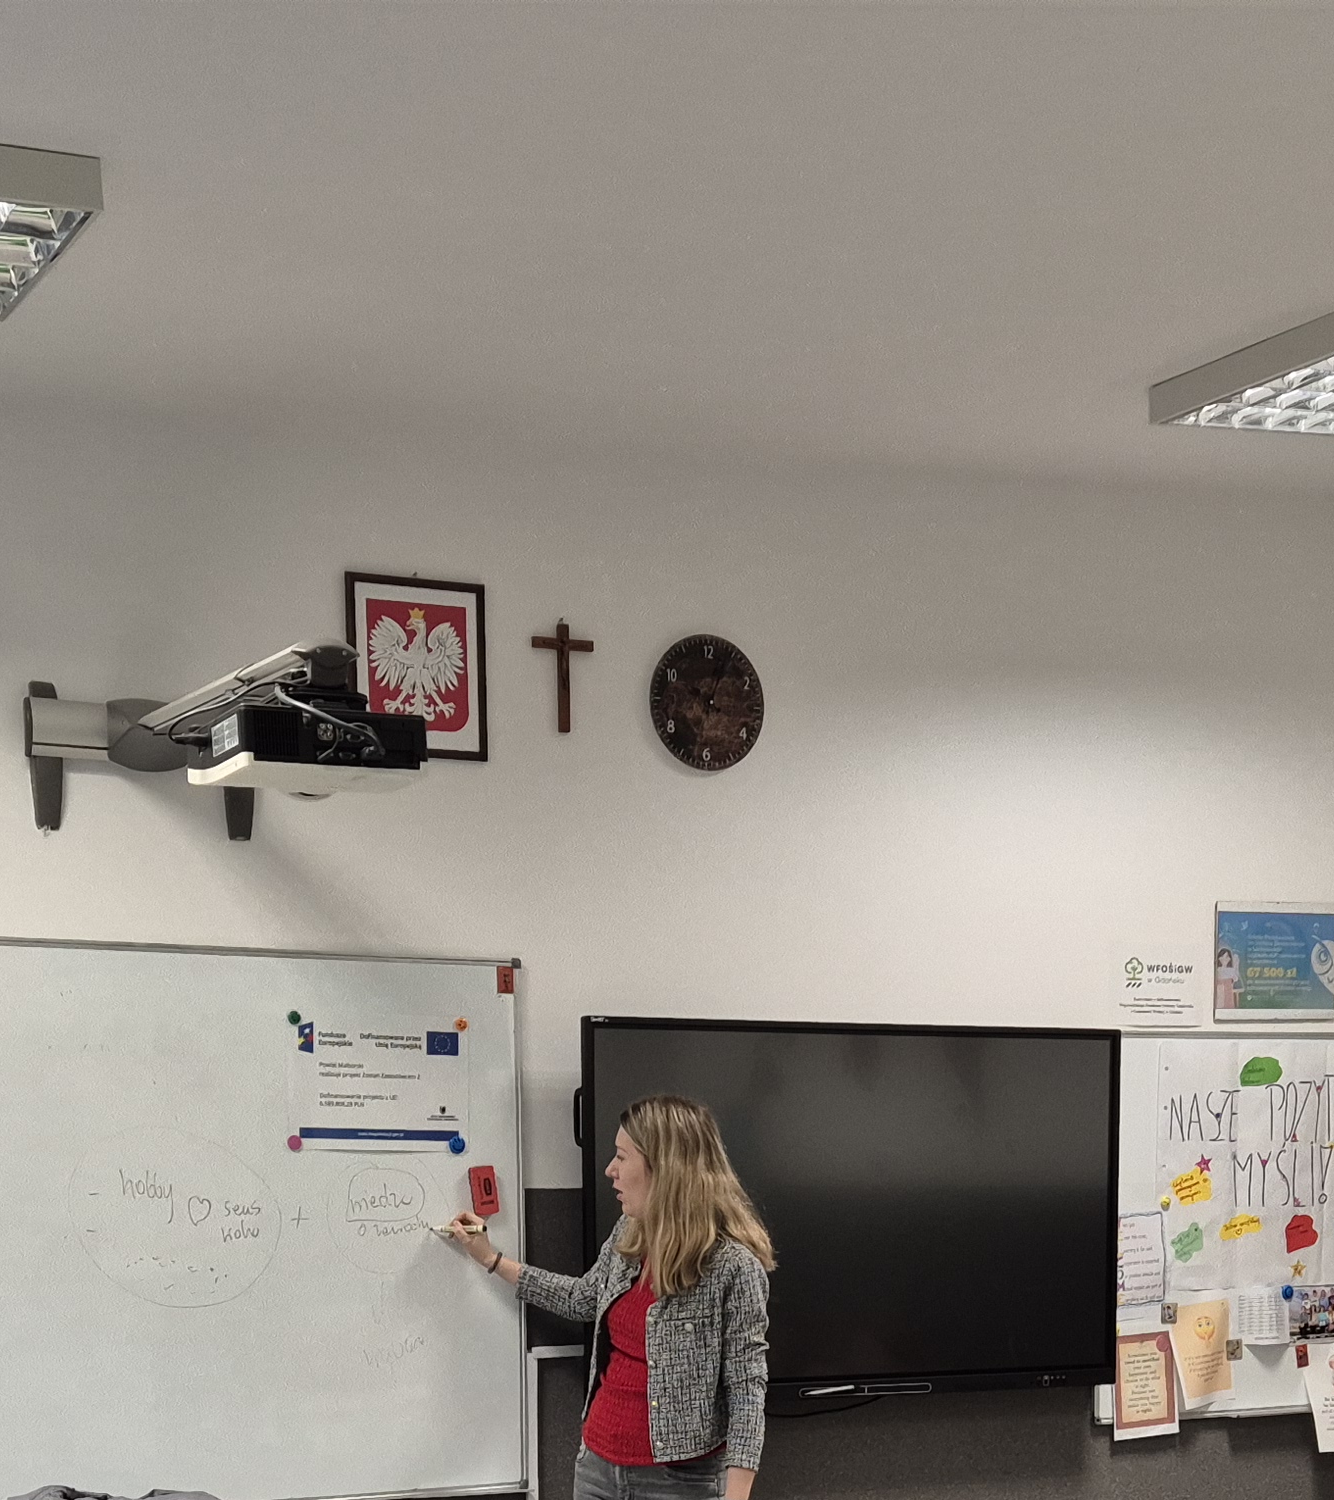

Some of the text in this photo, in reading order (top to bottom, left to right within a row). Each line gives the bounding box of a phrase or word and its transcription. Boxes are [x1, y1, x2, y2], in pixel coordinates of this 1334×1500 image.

[703, 645, 714, 660] 12
[667, 668, 678, 682] 10
[744, 677, 751, 690] 2
[666, 719, 676, 733] 8
[739, 726, 747, 740] 4
[702, 747, 711, 761] 6
[119, 1168, 174, 1225] hobby
